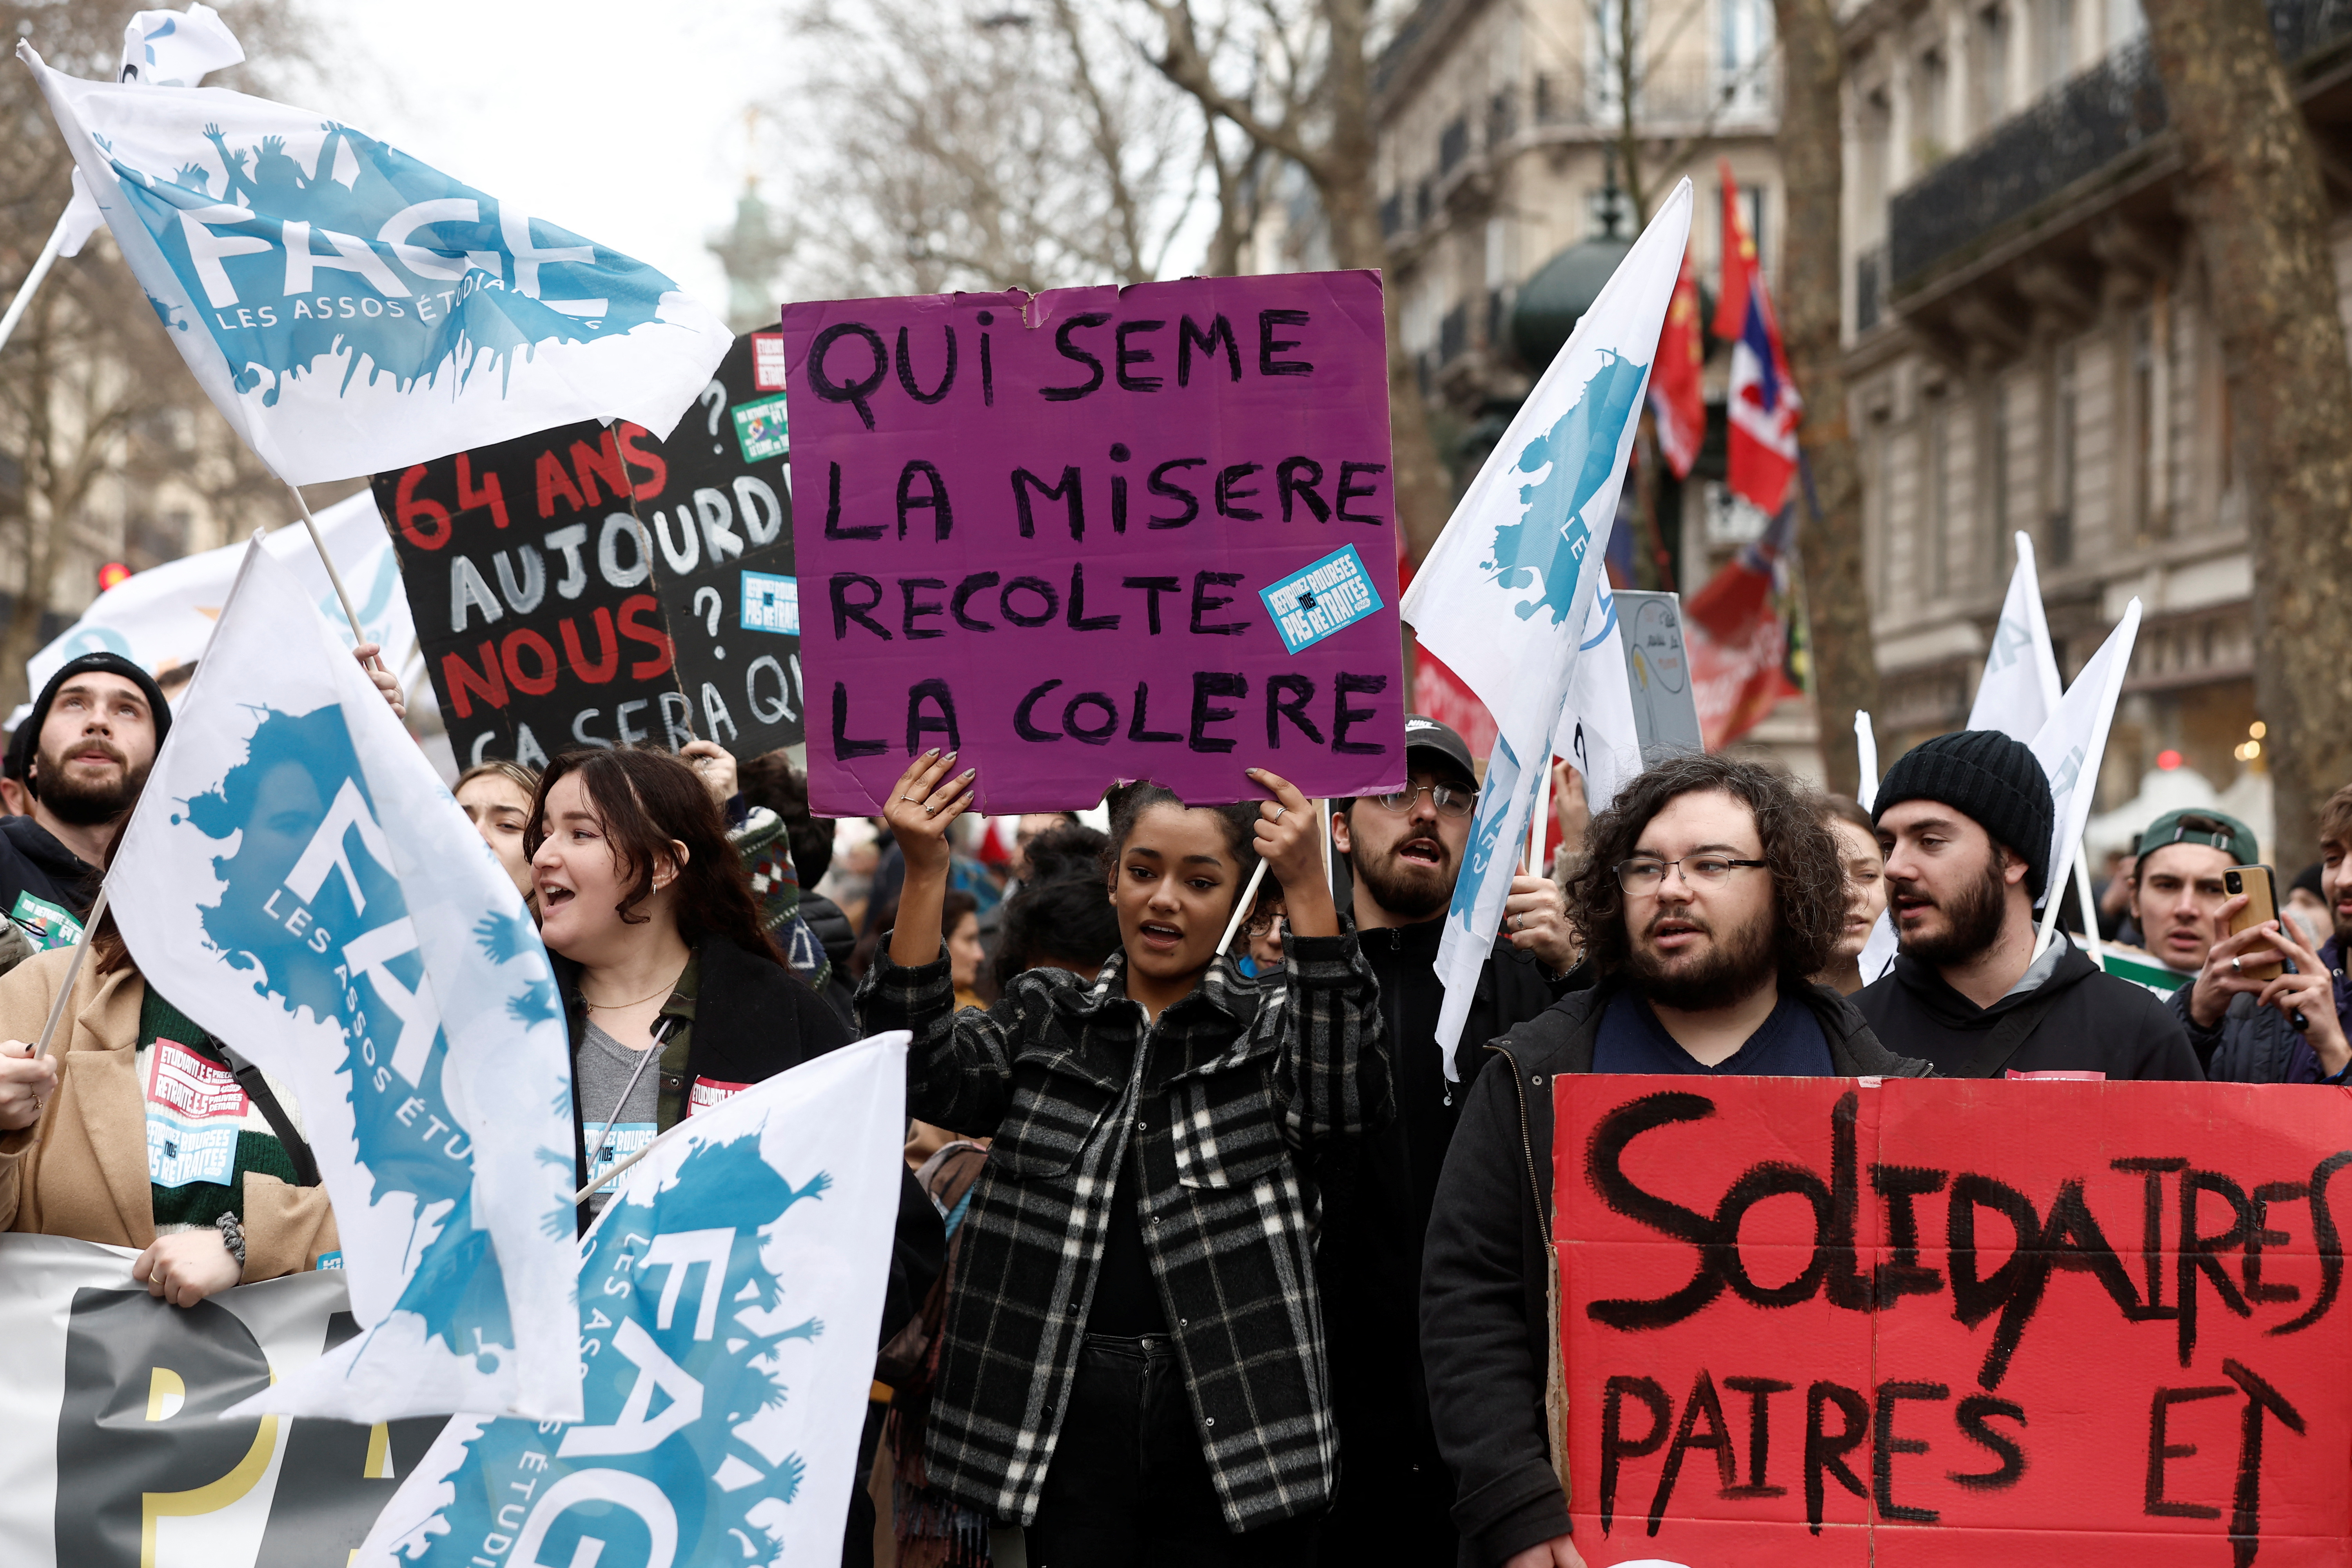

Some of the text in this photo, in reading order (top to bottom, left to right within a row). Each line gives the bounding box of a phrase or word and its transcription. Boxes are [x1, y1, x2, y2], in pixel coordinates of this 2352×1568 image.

[177, 198, 608, 317] FAGE
[215, 303, 277, 330] LES
[293, 297, 405, 320] ASSOS
[1038, 309, 1315, 402] SEME
[395, 452, 509, 550] 64
[535, 421, 668, 519] ANS
[824, 459, 953, 543] LA
[828, 561, 1253, 641] RECOLTE
[1268, 554, 1358, 617] REFORMEZ BOURSES
[1280, 575, 1369, 646] PAS RETRAITES
[1356, 600, 1369, 609] FAGE
[442, 586, 726, 718] NOUS ?
[1321, 620, 1351, 637] WWW.FAGE.ORG
[831, 678, 961, 761] LA
[1013, 671, 1387, 755] COLERE
[263, 888, 331, 954] LES
[334, 964, 392, 1094] ASSOS
[396, 1096, 476, 1173] ÉTU
[208, 1093, 243, 1105] PAUVRES
[208, 1101, 240, 1112] DEMAIN
[160, 1148, 228, 1183] RETRAITES
[180, 1129, 231, 1152] BOURSES
[604, 1232, 650, 1299] LES
[1599, 1368, 2029, 1540] PAIRES
[2143, 1357, 2307, 1568] ET
